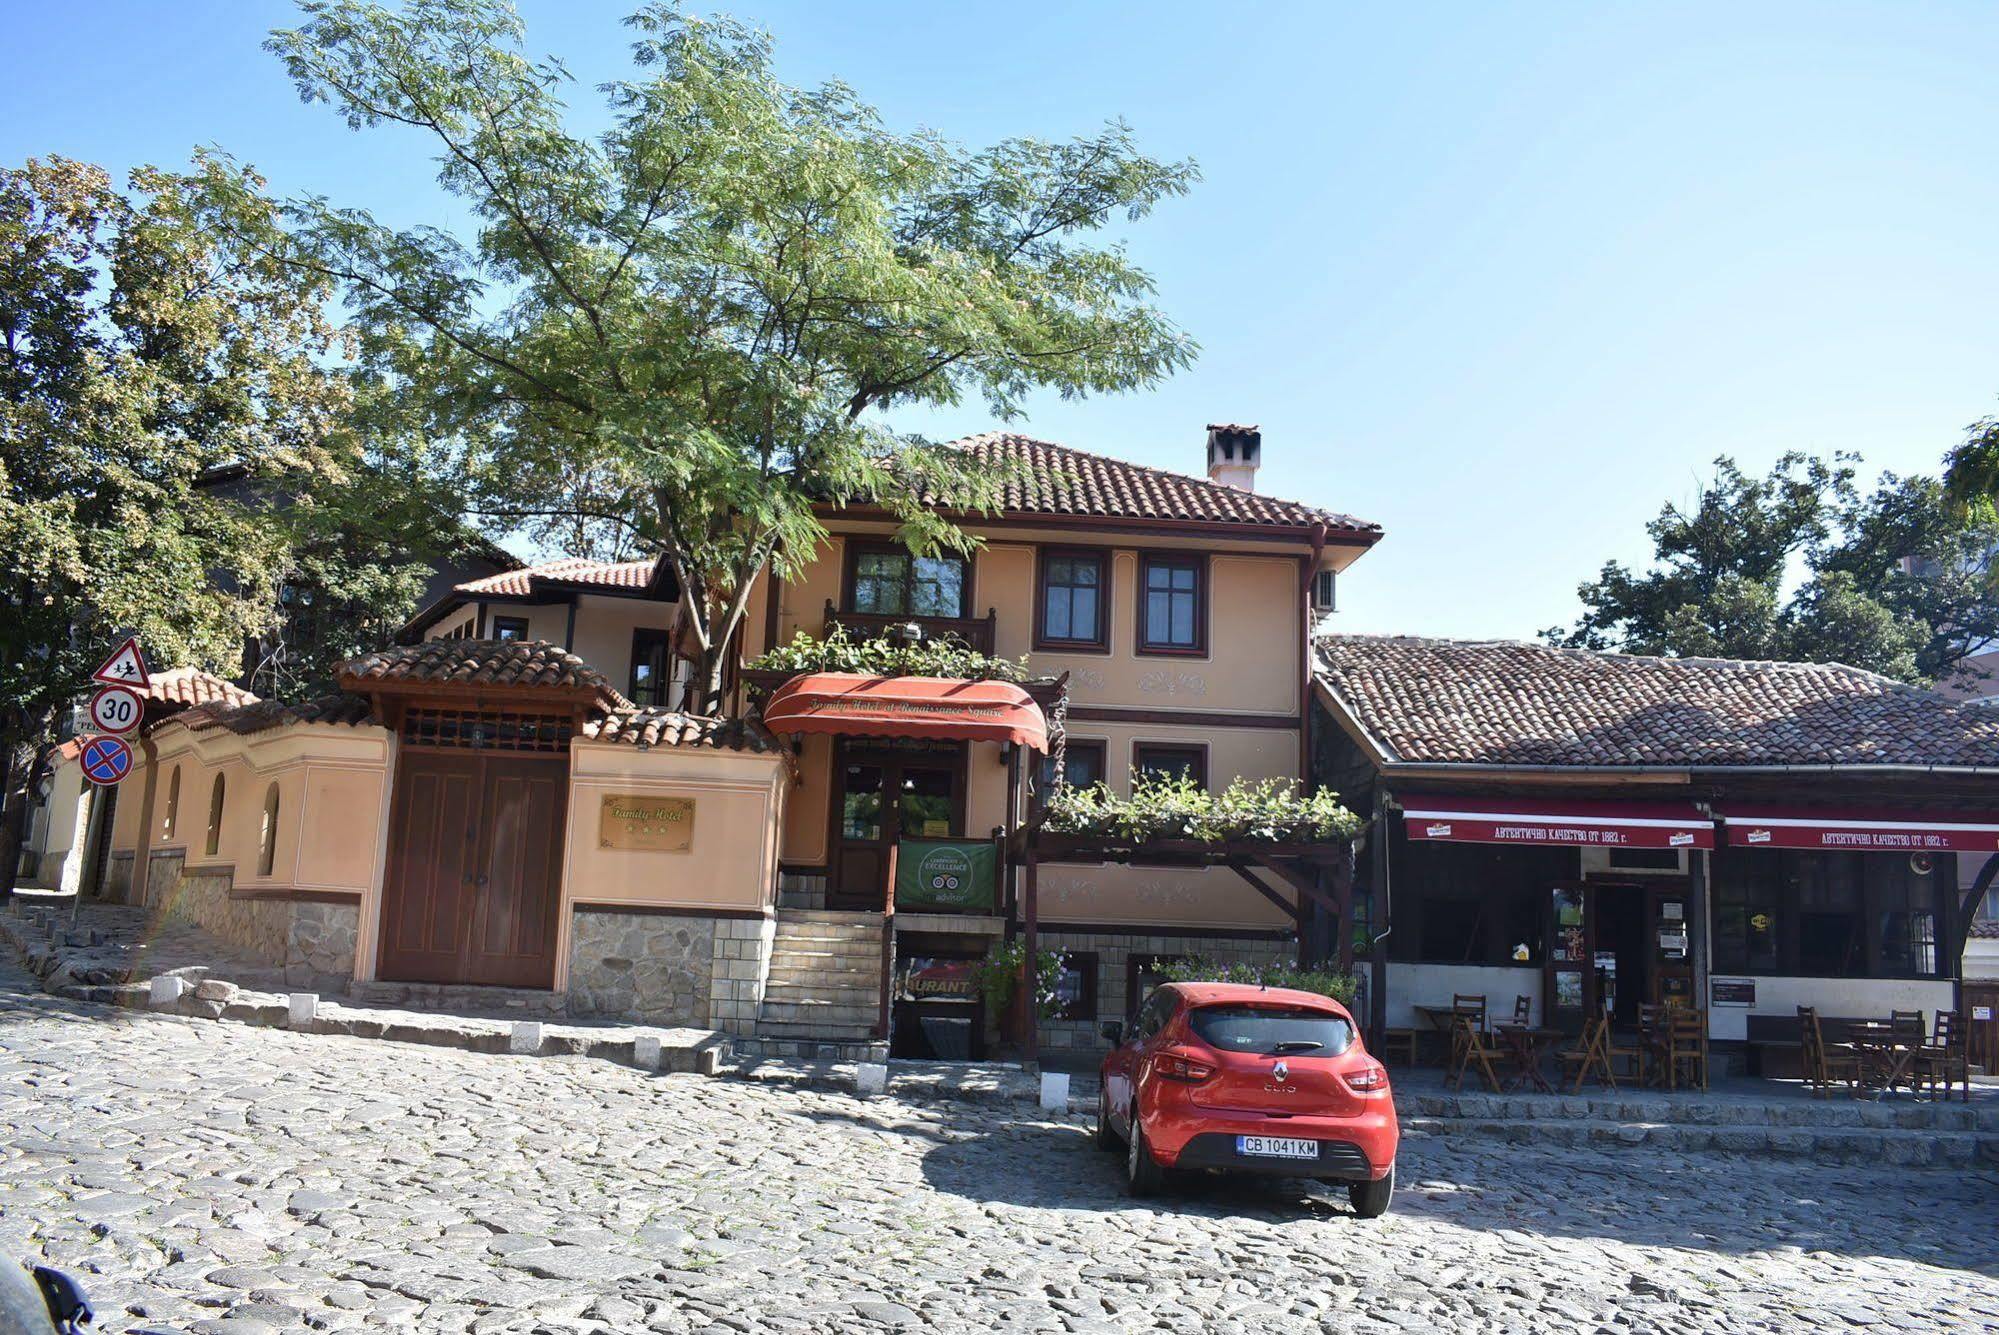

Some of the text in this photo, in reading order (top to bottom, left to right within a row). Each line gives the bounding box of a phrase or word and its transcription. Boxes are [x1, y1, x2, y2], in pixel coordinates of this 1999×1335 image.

[102, 699, 131, 722] 30
[808, 699, 1003, 718] Family Hotel at Renaissance Square
[612, 807, 684, 822] Family Hotel
[1494, 826, 1547, 840] АВТЕНТИЧНО
[1548, 828, 1587, 841] КАЧЕСТВО
[1588, 830, 1599, 842] ОТ
[1601, 831, 1619, 843] 1882
[1821, 832, 1871, 845] АВТЕНТИЧНО
[1872, 833, 1910, 847] КАЧЕСТВО
[1911, 835, 1921, 846] ОТ
[925, 863, 967, 871] EXCELLENCE
[1264, 1084, 1296, 1093] CLIO
[1266, 1139, 1296, 1155] 1041
